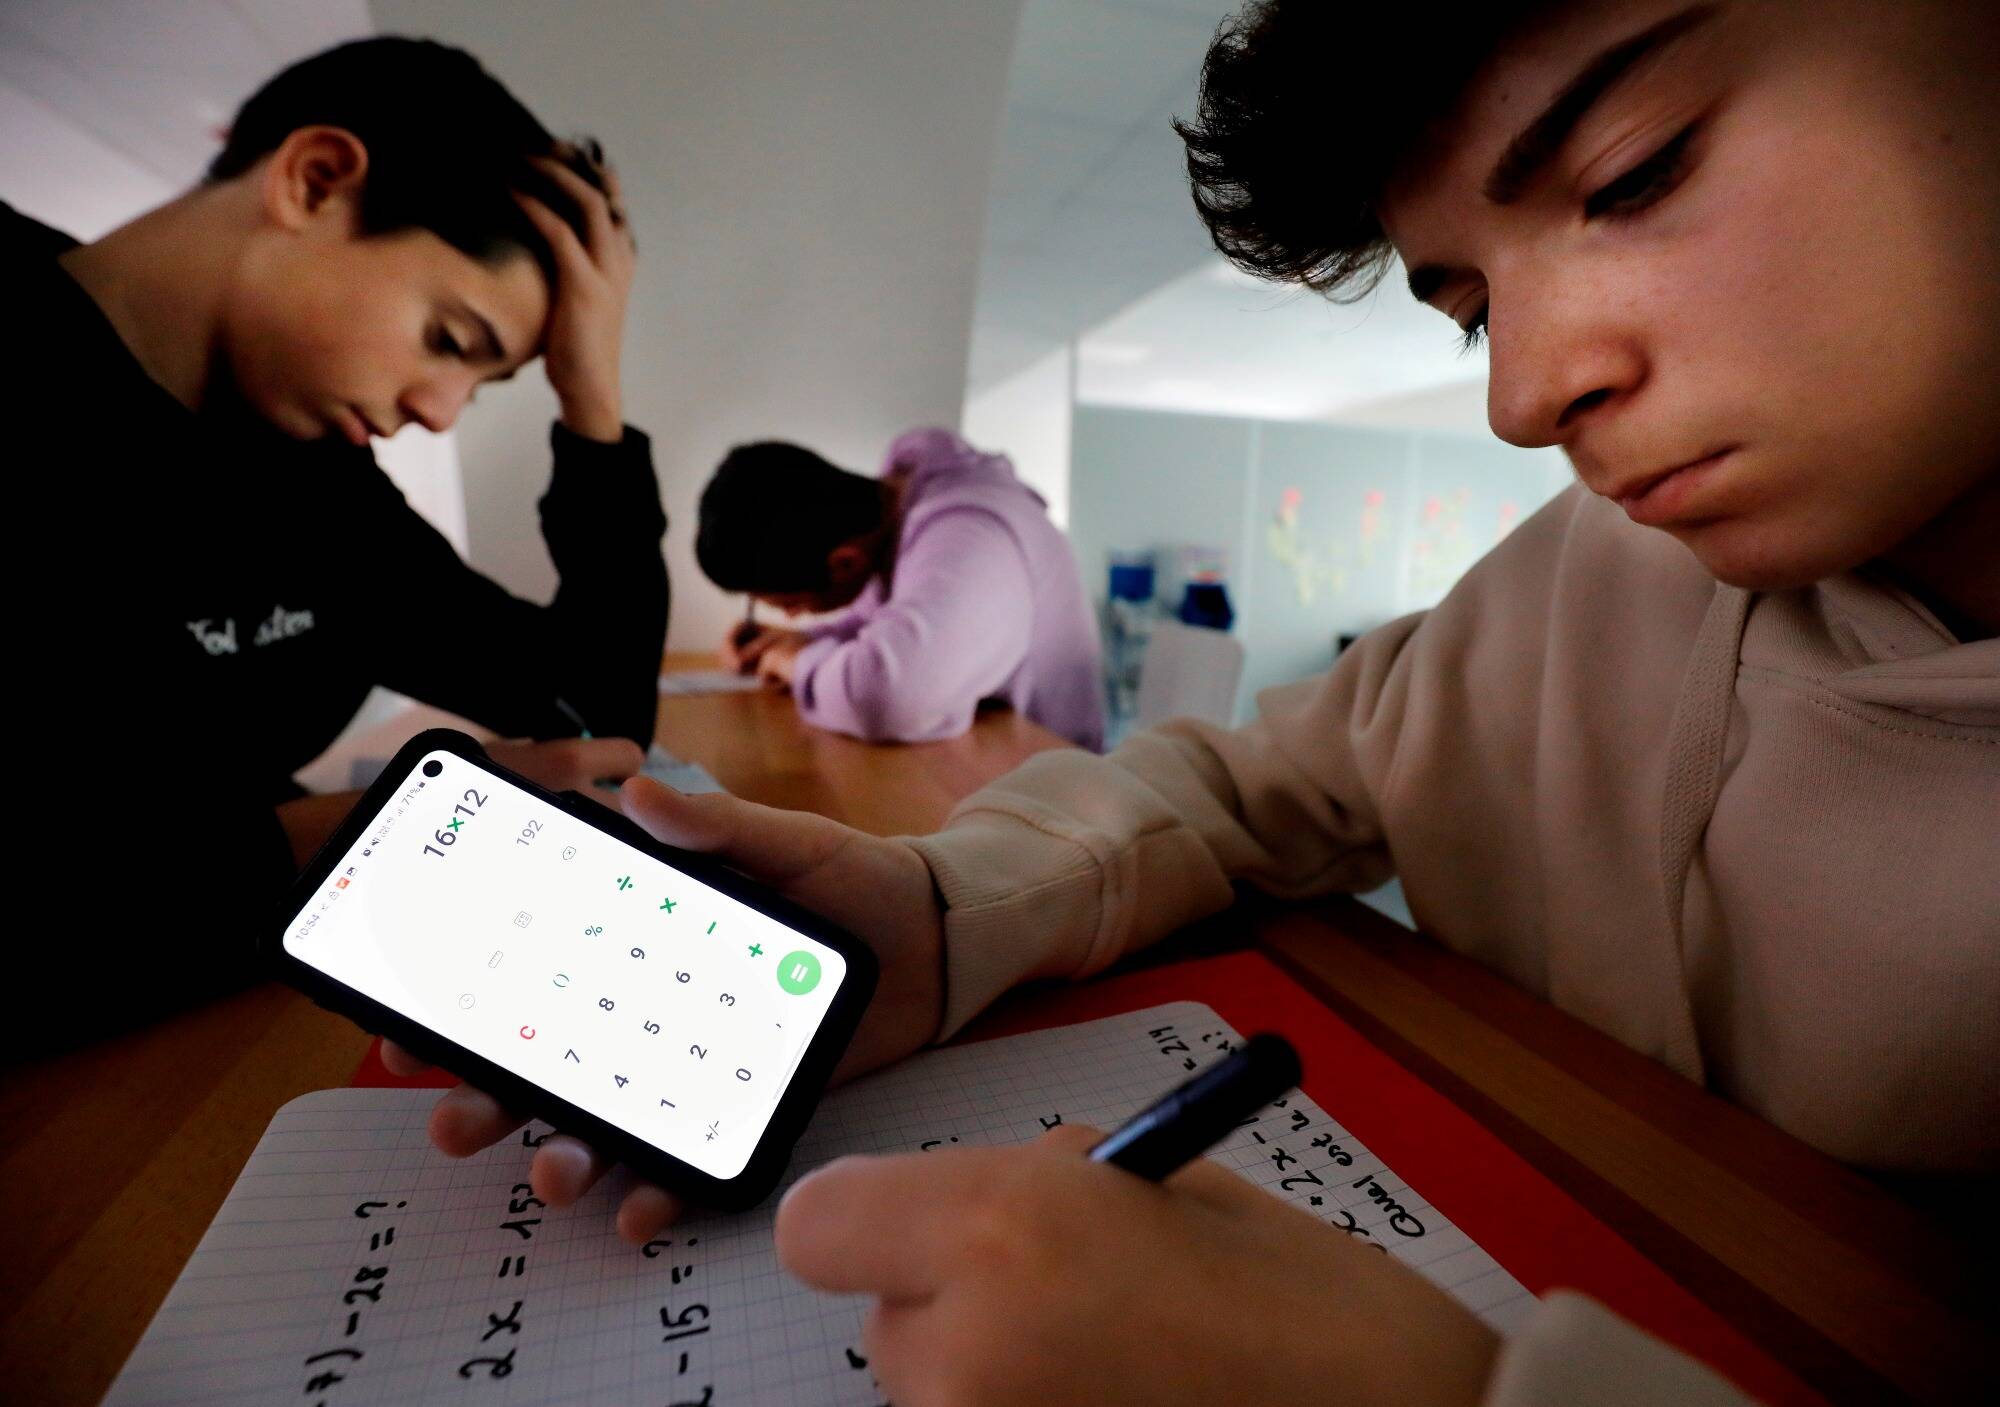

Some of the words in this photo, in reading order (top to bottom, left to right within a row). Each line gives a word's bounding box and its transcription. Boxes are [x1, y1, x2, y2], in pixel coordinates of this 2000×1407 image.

[296, 913, 320, 940] 10:54
[401, 787, 420, 806] 71%
[516, 819, 544, 847] 192
[519, 1025, 536, 1040] C
[584, 925, 603, 937] %
[564, 1048, 581, 1064] 7
[598, 997, 615, 1012] 8
[630, 947, 646, 960] 9
[613, 1073, 630, 1089] 4
[643, 1020, 661, 1035] 5
[675, 970, 691, 984] 6
[660, 1097, 676, 1109] 1
[689, 1044, 708, 1060] 2
[719, 992, 736, 1007] 3
[735, 1067, 752, 1082] 0
[1310, 1132, 1353, 1167] est
[1352, 1174, 1426, 1238] Quel
